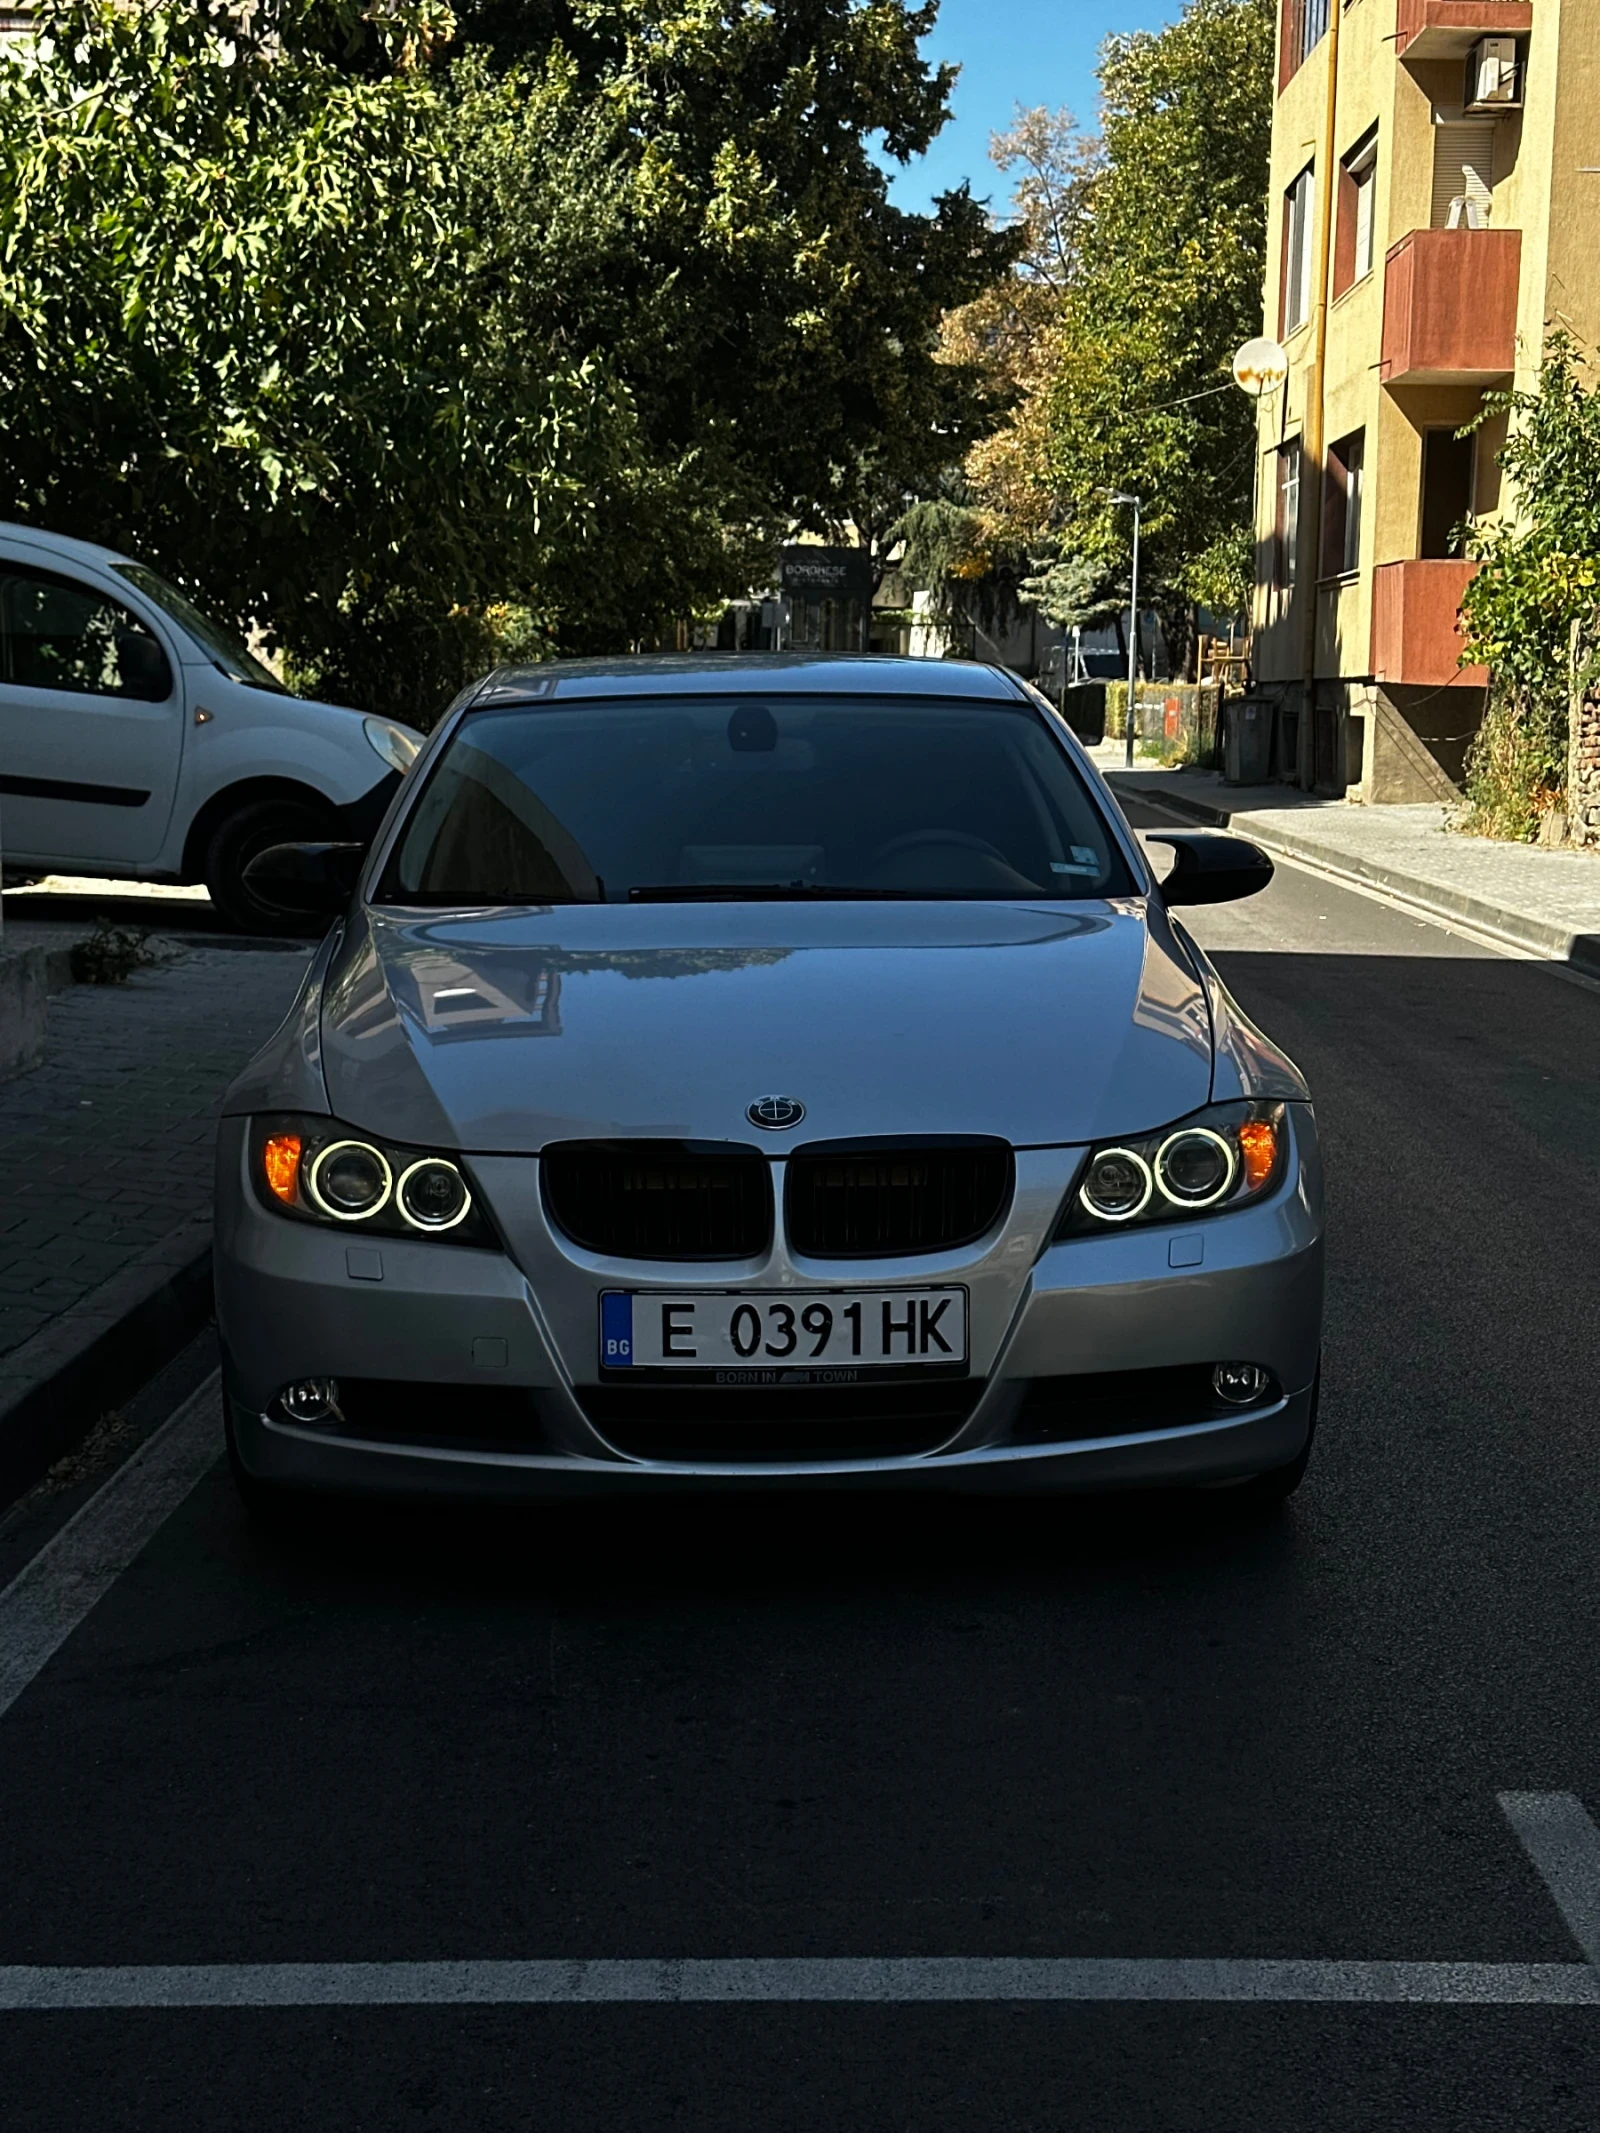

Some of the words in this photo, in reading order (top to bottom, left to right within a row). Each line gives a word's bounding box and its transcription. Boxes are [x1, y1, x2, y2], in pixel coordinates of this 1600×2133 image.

[662, 1303, 697, 1357] E
[607, 1339, 630, 1355] BG
[716, 1371, 757, 1384] BORN
[762, 1371, 776, 1383] IN
[814, 1370, 858, 1383] TOWN
